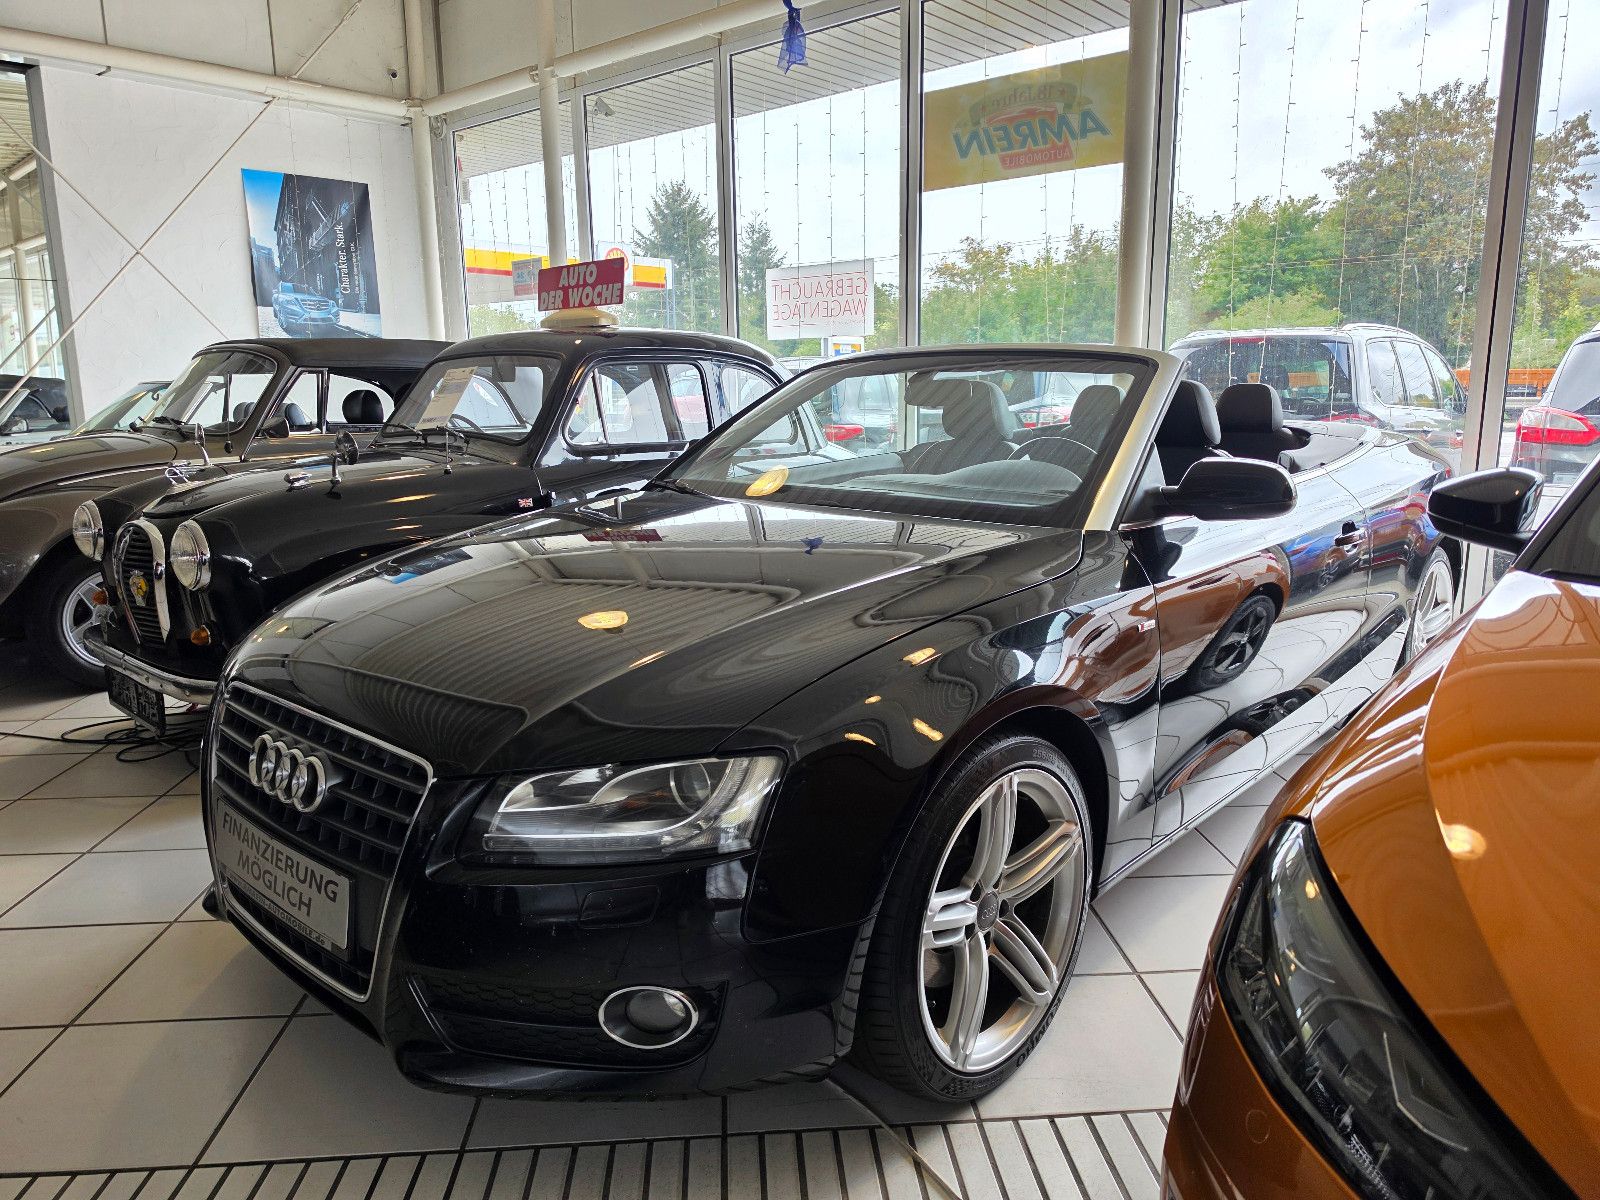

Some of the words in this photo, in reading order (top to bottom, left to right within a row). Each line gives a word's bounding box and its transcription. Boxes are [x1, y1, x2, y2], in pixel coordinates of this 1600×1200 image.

[334, 222, 346, 248] Stark.
[559, 263, 598, 288] AUTO
[540, 289, 564, 311] DER
[568, 282, 622, 308] WOCHE
[222, 811, 339, 903] FINANZIERUNG
[237, 850, 313, 917] MÖGLICH
